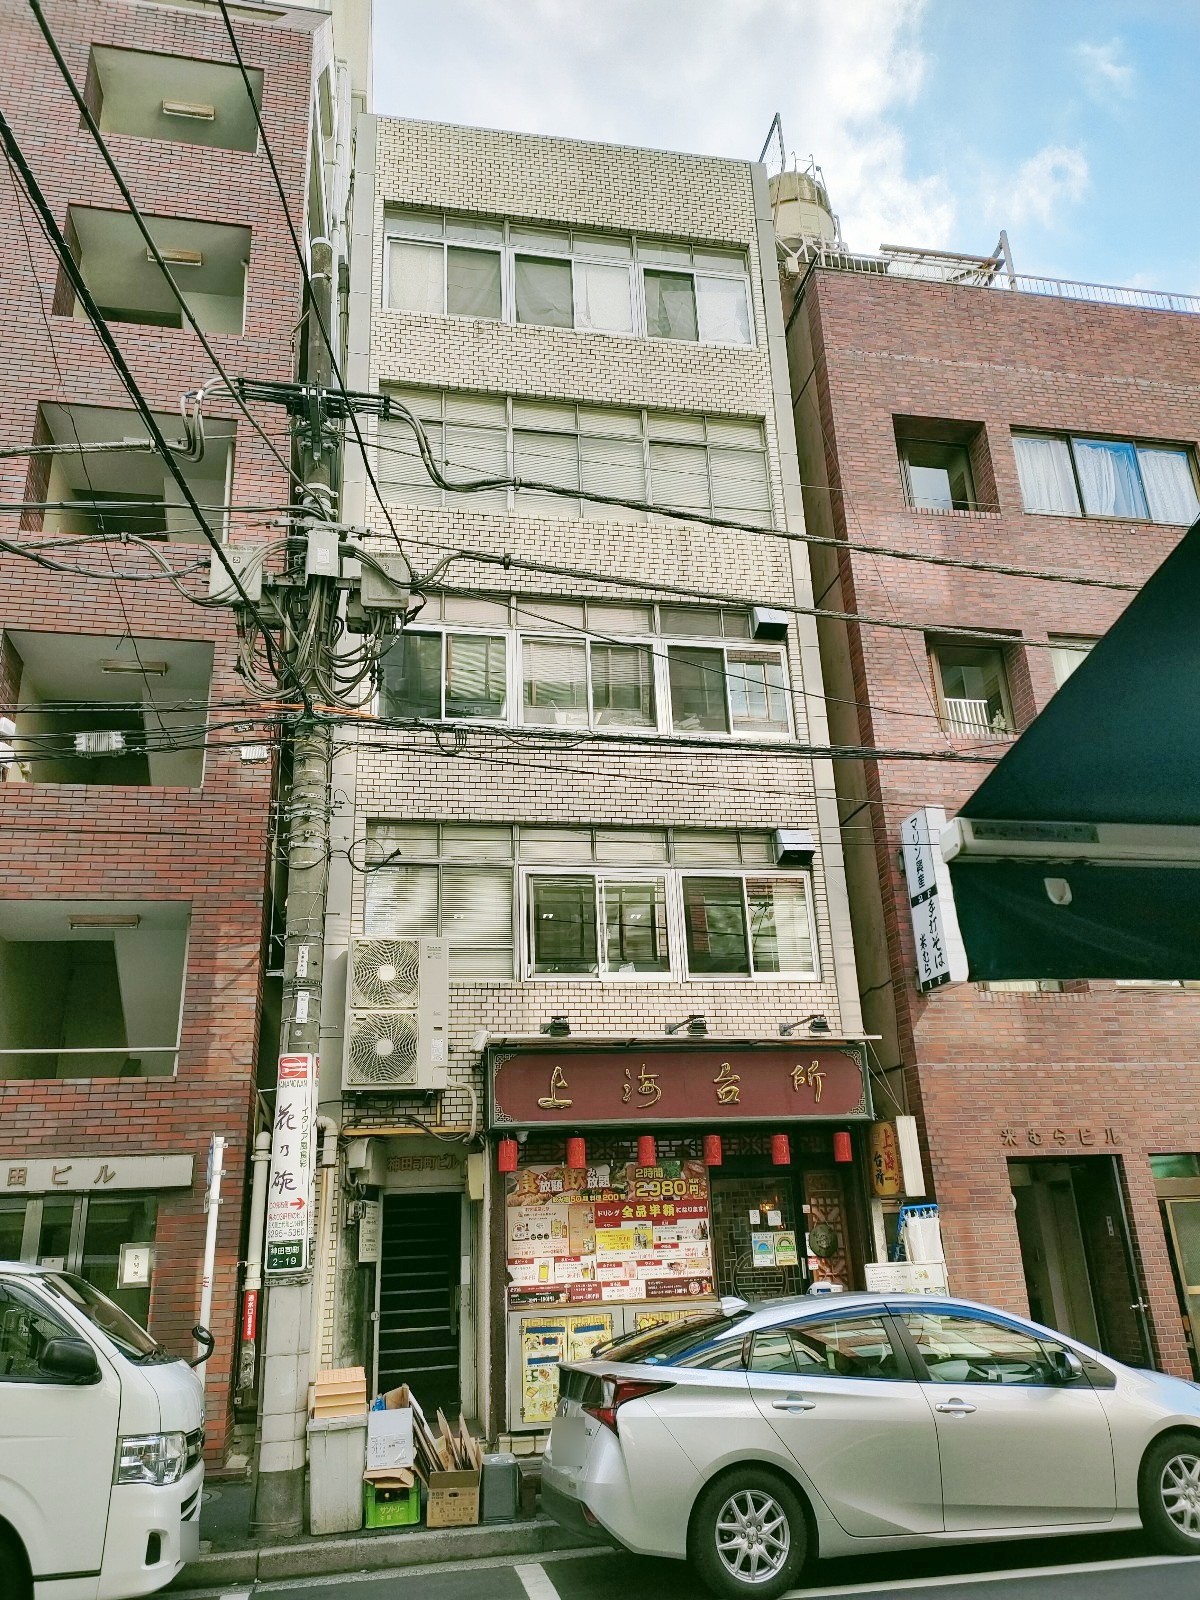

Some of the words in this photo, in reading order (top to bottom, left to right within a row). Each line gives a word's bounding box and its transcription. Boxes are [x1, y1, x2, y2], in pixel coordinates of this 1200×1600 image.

[918, 890, 932, 904] 2F
[928, 976, 943, 989] 1F
[538, 1060, 827, 1108] 上海台所
[1001, 1128, 1121, 1147] 米むらビル
[7, 1164, 116, 1187] 田ビル
[635, 1167, 664, 1179] 2時間
[621, 1204, 675, 1218] 全品半額
[272, 1256, 297, 1266] 2-19
